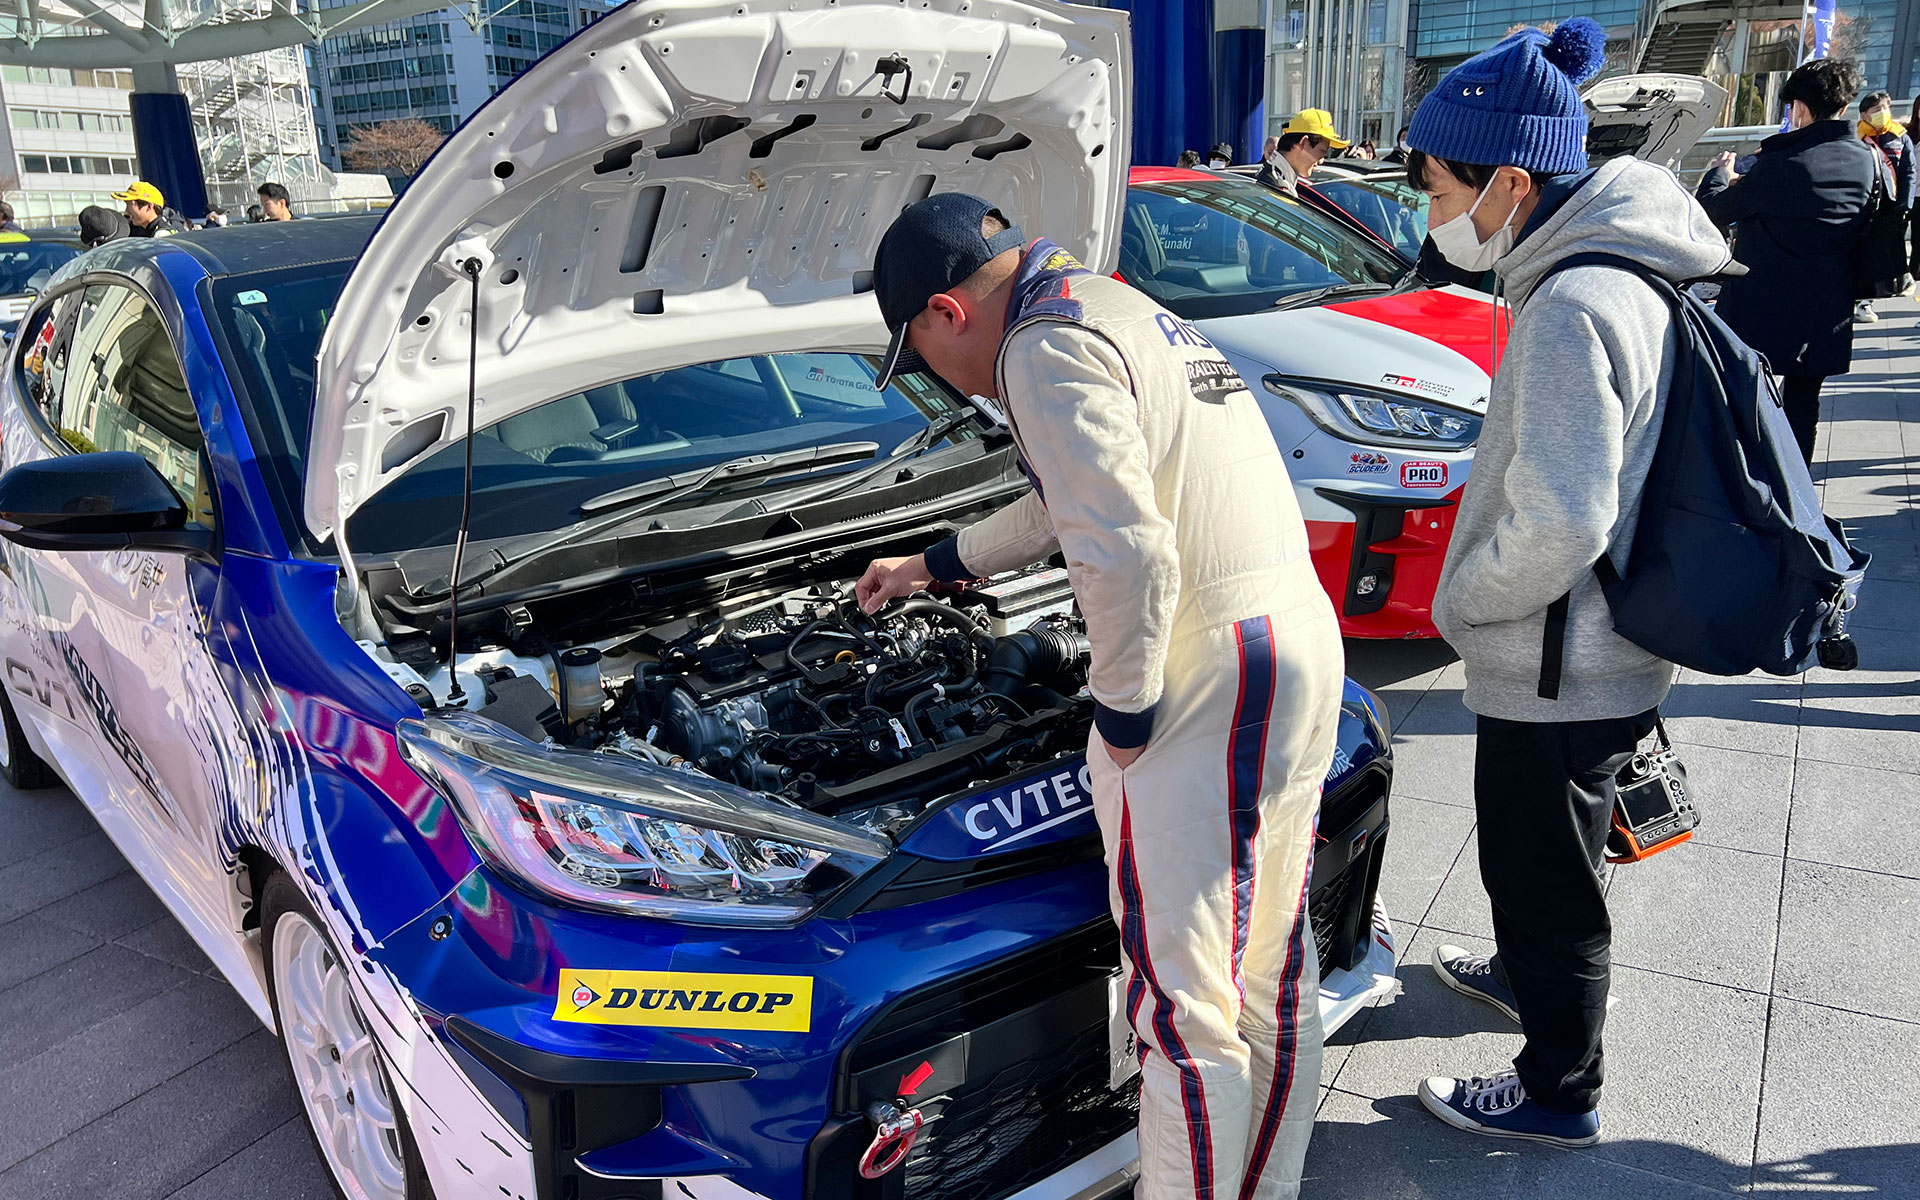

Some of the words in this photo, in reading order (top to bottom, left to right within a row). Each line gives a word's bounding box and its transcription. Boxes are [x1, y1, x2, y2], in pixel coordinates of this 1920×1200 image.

[1159, 237, 1192, 249] Funaki
[1186, 361, 1221, 379] RALLY
[825, 375, 855, 388] TOYOTA
[1381, 374, 1416, 388] GR
[1191, 382, 1208, 394] with
[1349, 464, 1389, 473] SCUDERIA
[1409, 468, 1438, 480] PRO
[603, 988, 794, 1014] DUNLOP
